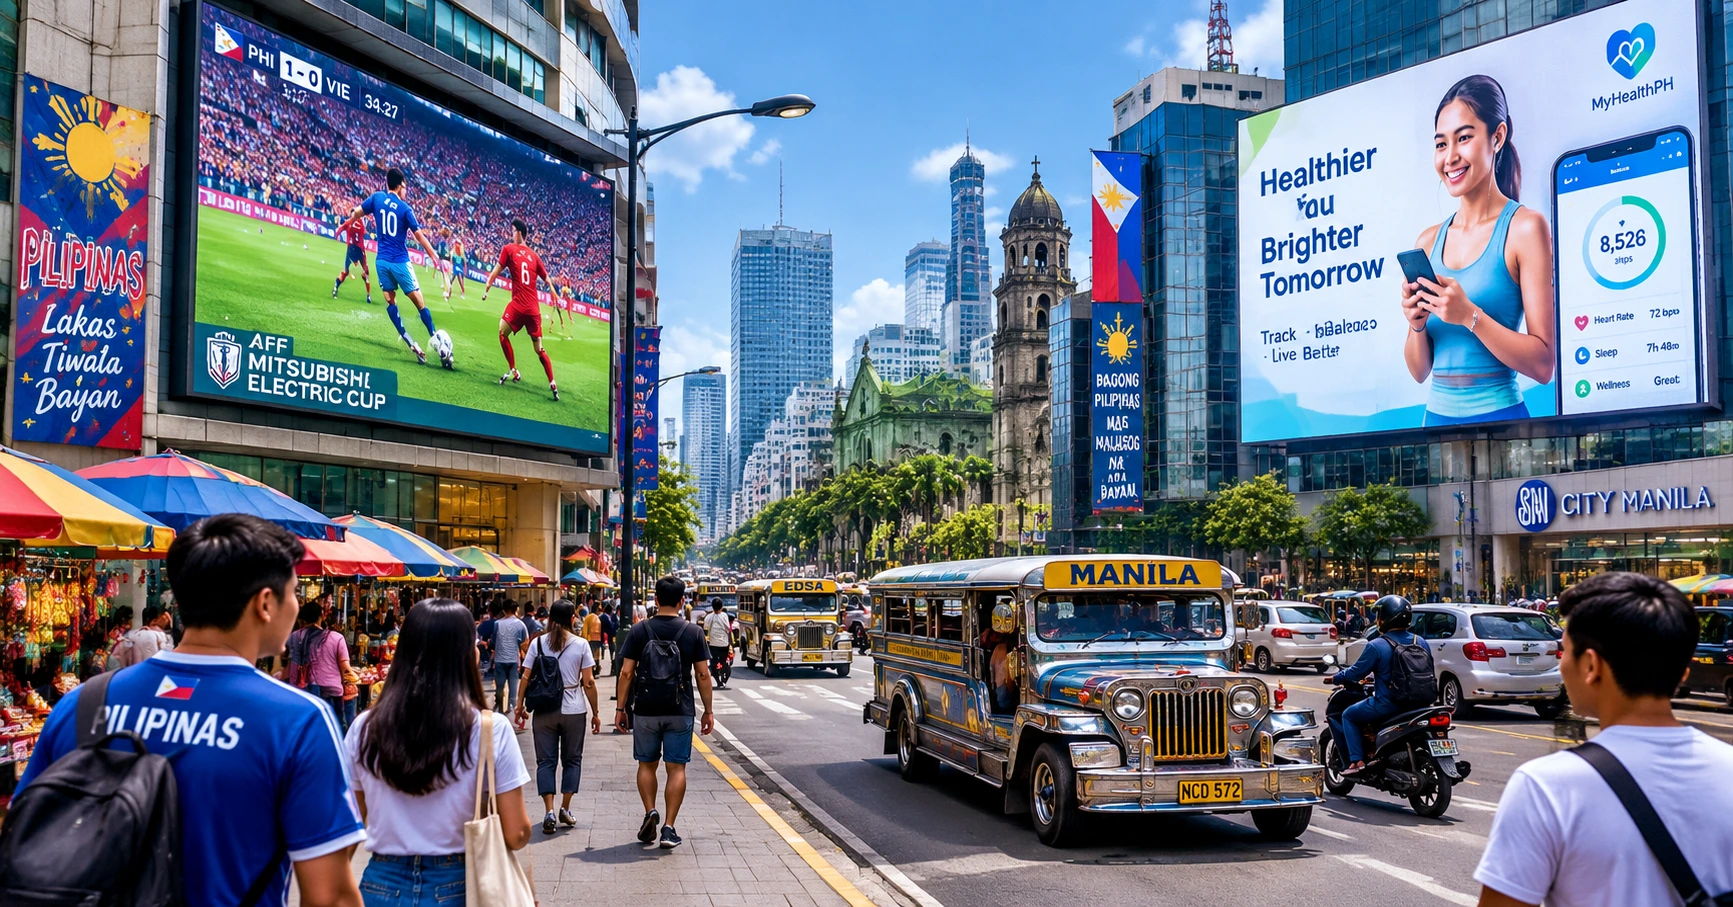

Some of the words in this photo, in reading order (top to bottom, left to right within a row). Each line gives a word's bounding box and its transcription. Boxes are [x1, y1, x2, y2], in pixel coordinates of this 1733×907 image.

[249, 44, 274, 69] PHI
[326, 76, 350, 100] VIE
[1592, 76, 1674, 111] MyHealthPH
[1260, 147, 1377, 197] Healthier
[380, 208, 398, 237] 10
[1261, 224, 1364, 264] Brighter
[1600, 228, 1646, 254] 8,526
[521, 262, 530, 286] 6
[1260, 257, 1385, 298] Tomorrow
[41, 303, 117, 339] Lakas
[1616, 312, 1634, 322] Rate
[1650, 309, 1661, 318] 72
[249, 332, 288, 354] AFF
[1260, 327, 1296, 345] Track
[1595, 348, 1618, 359] Sleep
[1646, 342, 1658, 353] 7h
[42, 342, 124, 375] Tiwala
[1272, 347, 1297, 363] Live
[34, 377, 122, 423] Bayan
[248, 374, 342, 404] ELECTRIC
[347, 390, 386, 410] CUP
[1561, 491, 1614, 515] CITY
[1621, 486, 1712, 512] MANILA
[784, 581, 824, 590] EDSA
[1070, 563, 1202, 585] MANILA
[1182, 783, 1209, 800] NCD
[1214, 782, 1240, 798] 572
